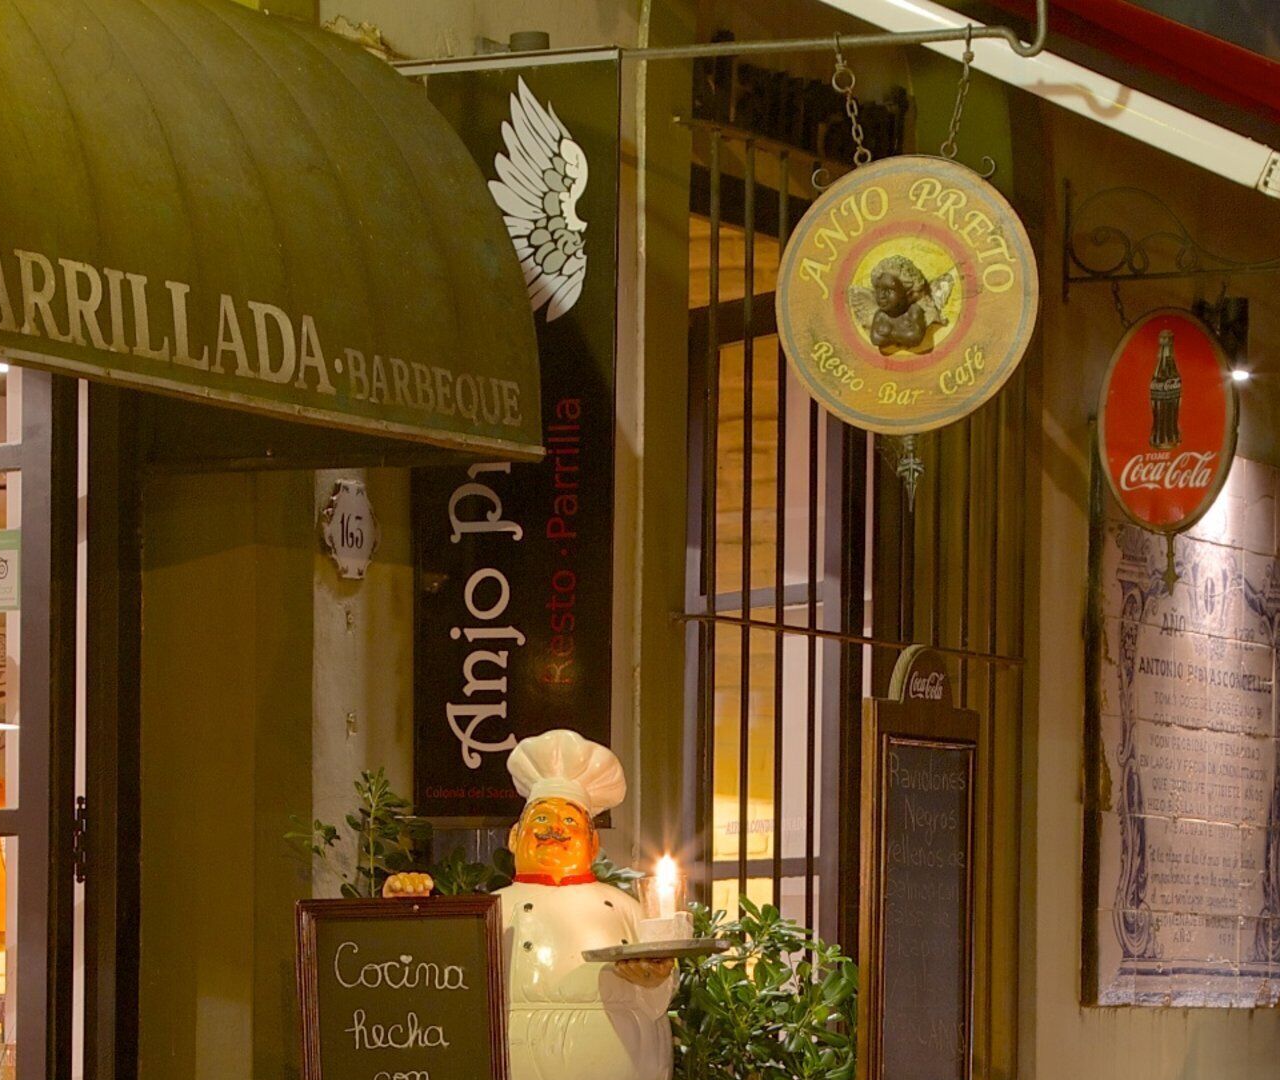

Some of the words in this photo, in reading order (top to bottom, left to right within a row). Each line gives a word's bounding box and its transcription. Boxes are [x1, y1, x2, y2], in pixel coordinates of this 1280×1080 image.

[799, 186, 889, 299] ANJO
[909, 177, 1017, 294] PRETO
[344, 347, 523, 427] BARBEQUE
[811, 341, 864, 392] Resto
[878, 381, 924, 405] Bar
[939, 345, 986, 396] Café
[546, 398, 583, 541] Parrilla
[1120, 451, 1217, 491] Coca-Cola
[339, 512, 365, 549] 165
[541, 570, 580, 686] Resto
[446, 567, 526, 770] Anjo
[908, 670, 945, 700] Coca-Cola
[334, 941, 470, 990] Cocina
[344, 1009, 451, 1050] hecha
